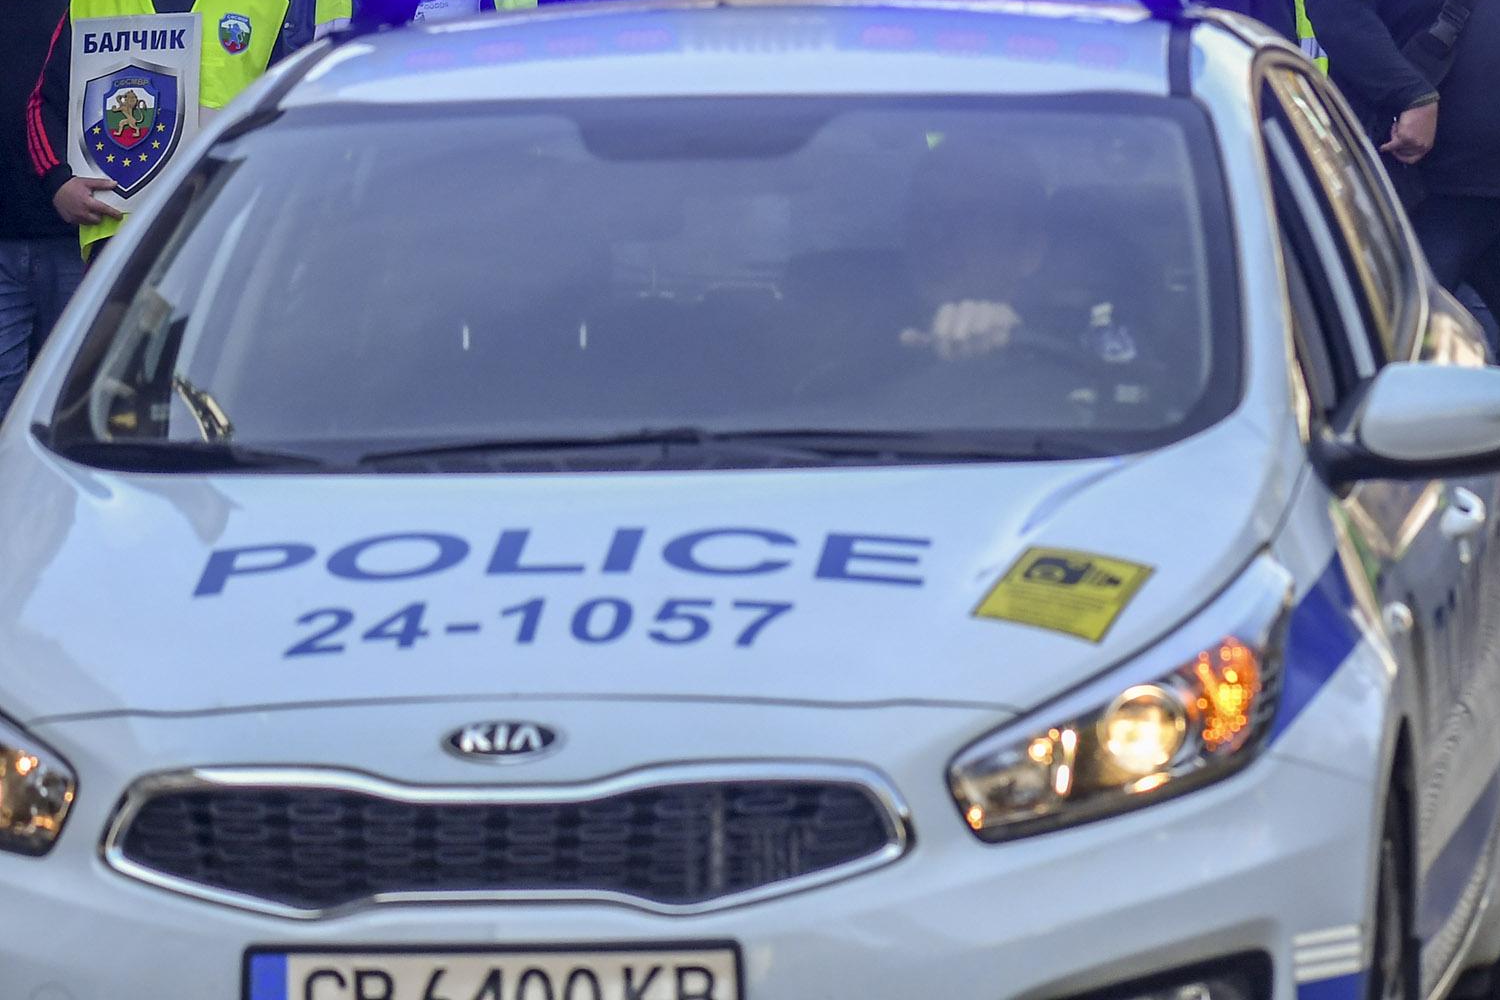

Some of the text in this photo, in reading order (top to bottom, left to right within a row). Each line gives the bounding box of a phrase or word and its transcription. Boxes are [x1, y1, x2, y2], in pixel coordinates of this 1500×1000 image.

[83, 28, 187, 54] БАЛЧИК
[192, 526, 934, 598] POLICE
[282, 596, 798, 659] 24-1057
[461, 724, 543, 753] KIA
